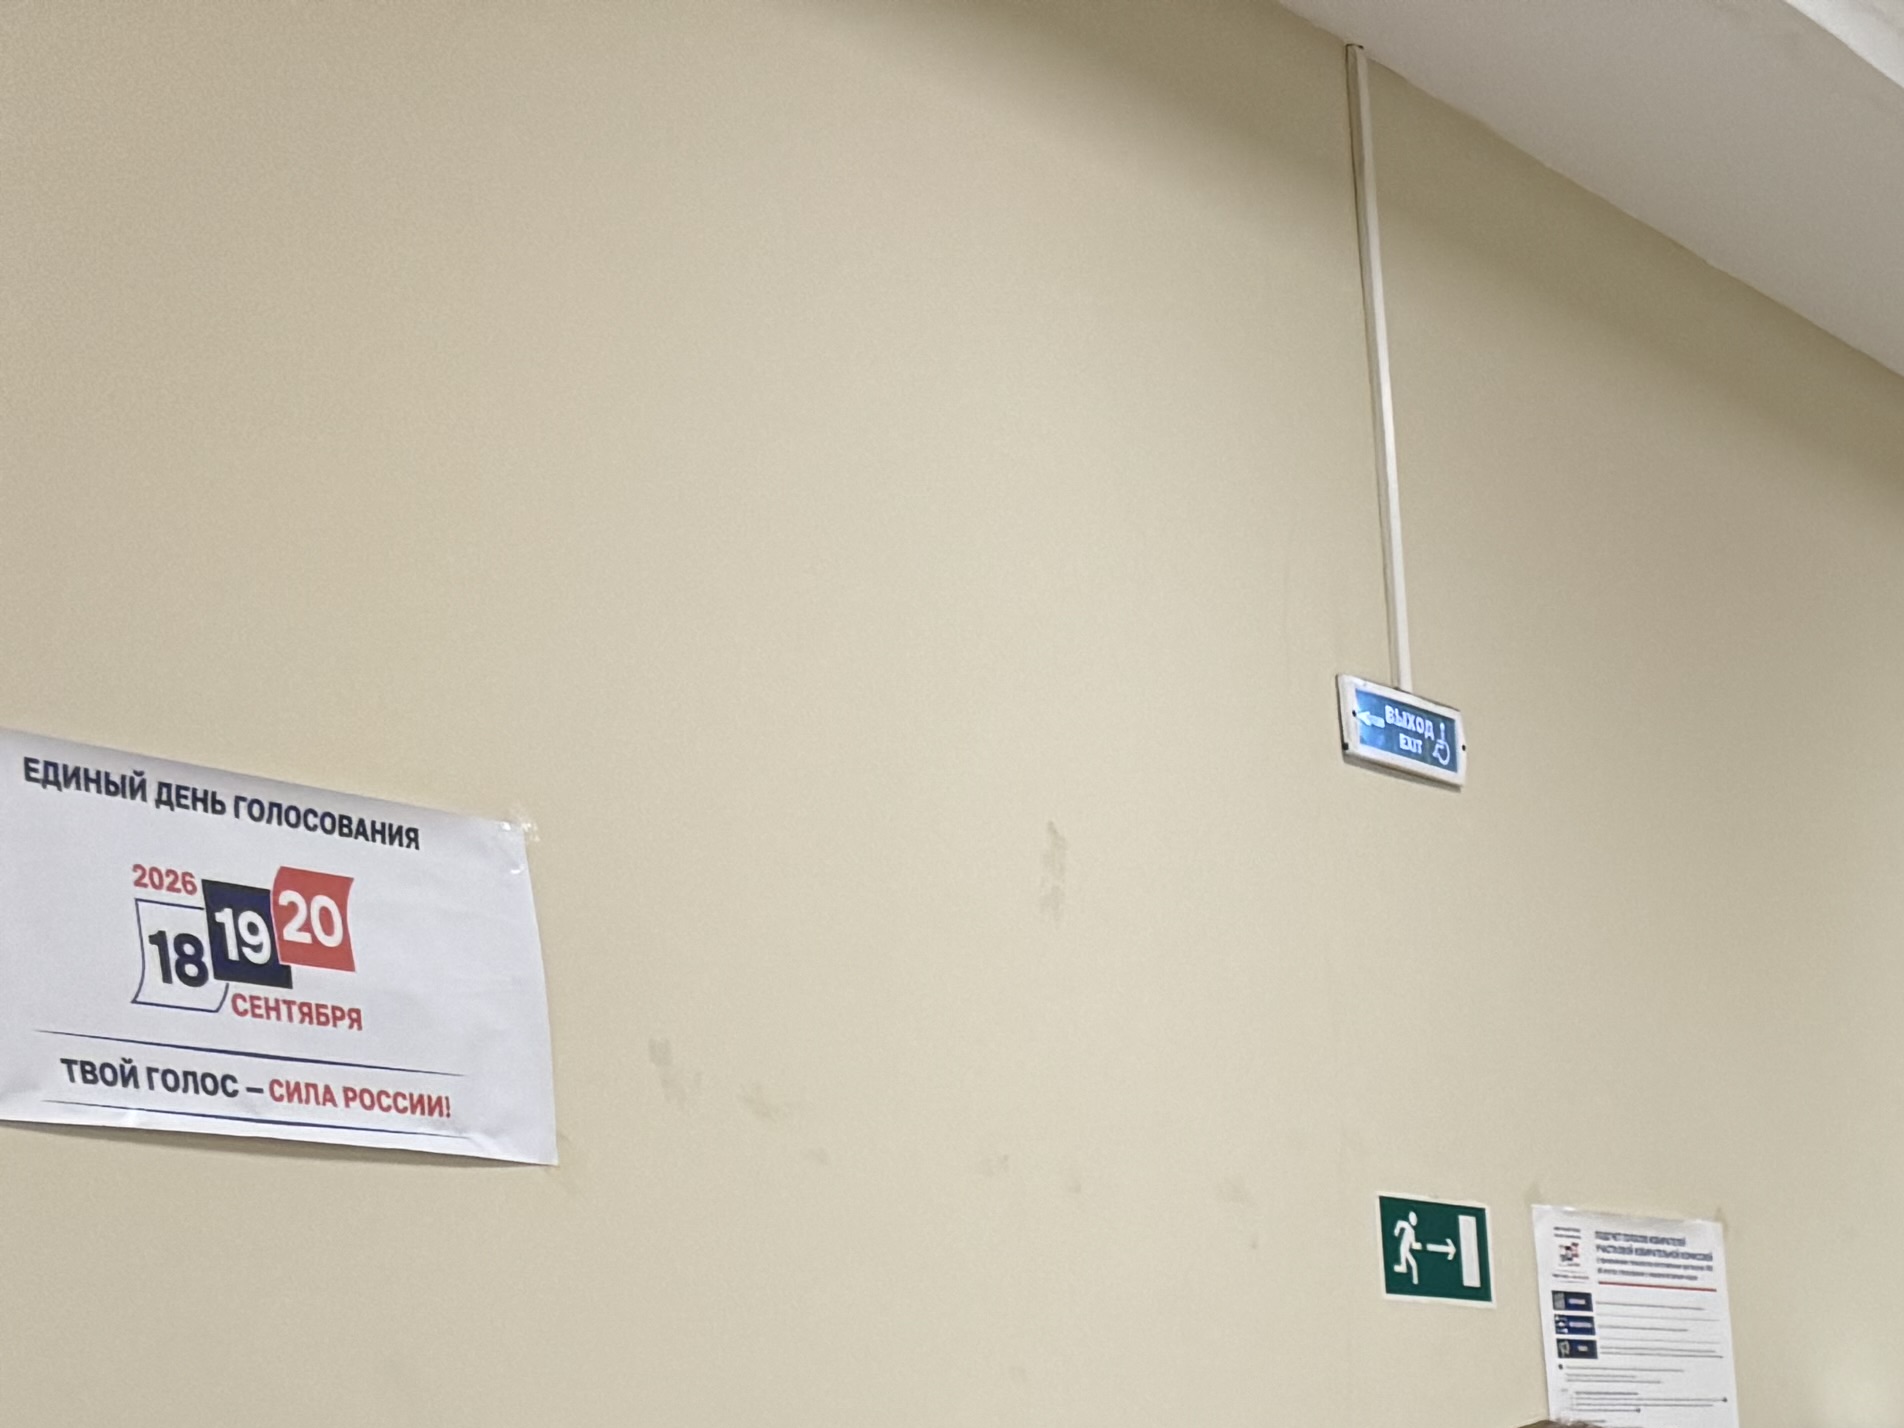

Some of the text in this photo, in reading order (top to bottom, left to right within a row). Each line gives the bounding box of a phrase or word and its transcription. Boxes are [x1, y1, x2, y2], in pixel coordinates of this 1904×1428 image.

[1385, 705, 1434, 740] ВЫХОД
[1399, 733, 1422, 754] EXIT
[22, 756, 420, 851] ЕДИНЫЙ ДЕНЬ ГОЛОСОВАНИЯ
[131, 864, 197, 896] 2026
[148, 889, 344, 989] 18 19 20
[230, 992, 364, 1031] СЕНТЯБРЯ
[61, 1057, 140, 1091] ТВОЙ
[146, 1066, 239, 1099] ГОЛОС
[268, 1079, 338, 1108] СИЛА
[343, 1088, 452, 1118] РОССИИ!
